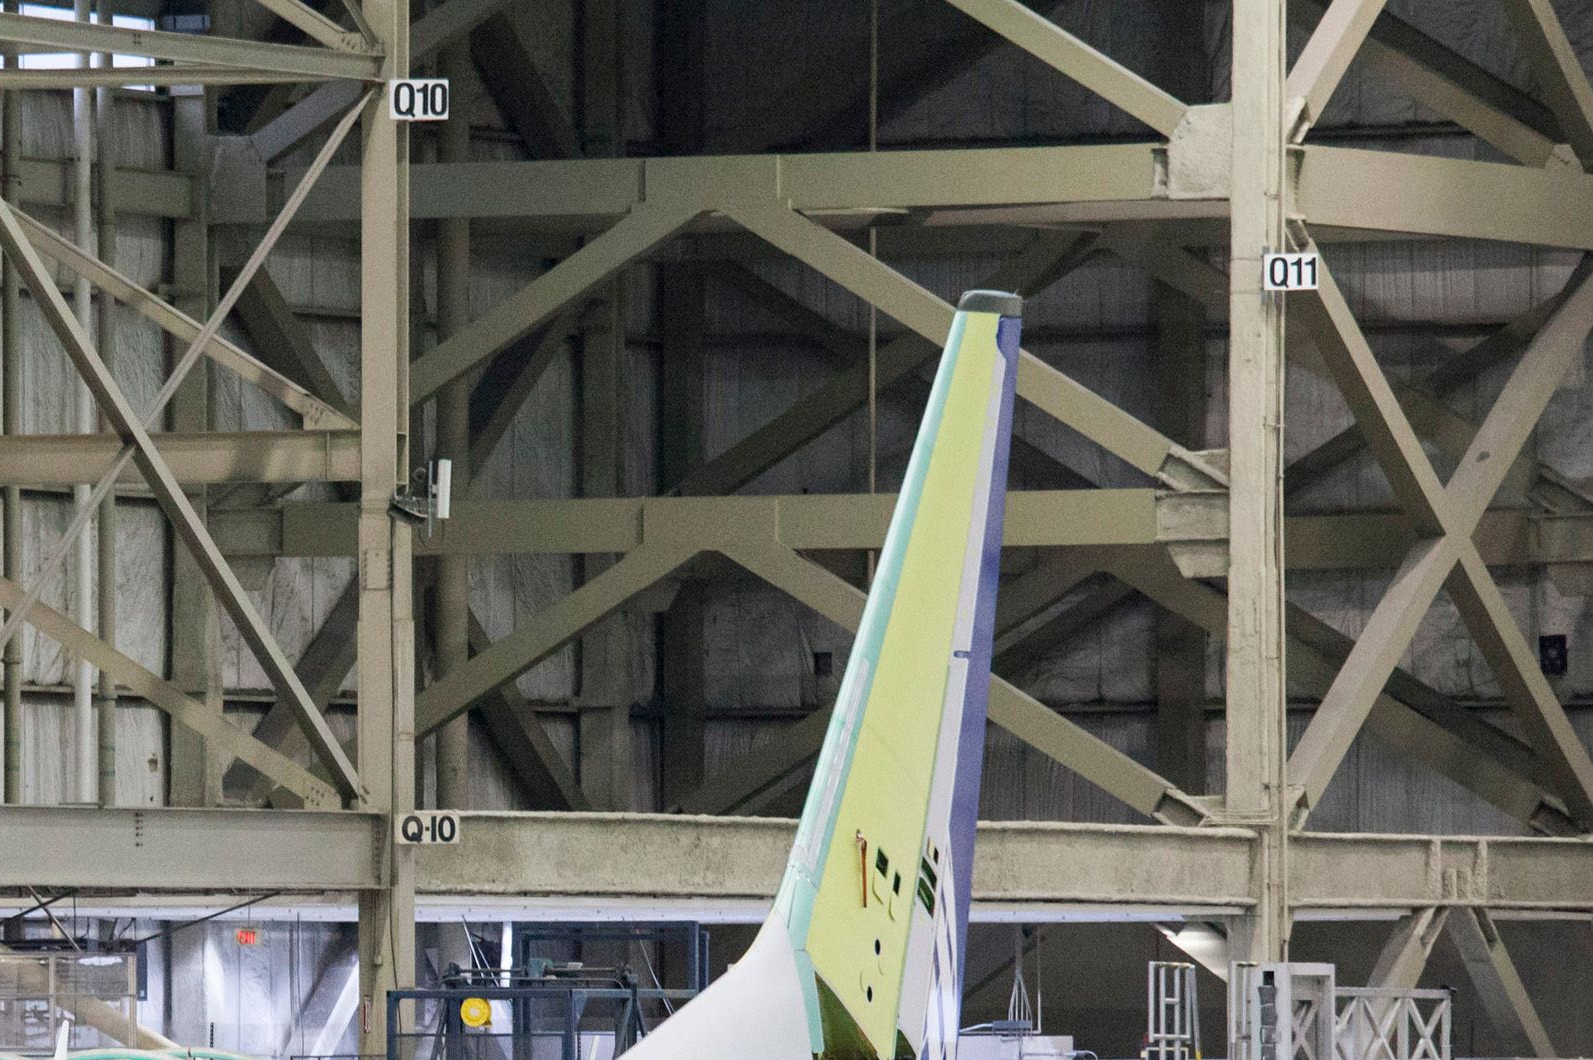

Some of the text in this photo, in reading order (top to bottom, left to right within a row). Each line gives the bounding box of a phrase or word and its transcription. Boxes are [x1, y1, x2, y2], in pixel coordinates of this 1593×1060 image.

[394, 82, 447, 117] Q10
[1270, 257, 1316, 288] Q11
[402, 815, 455, 843] Q-10
